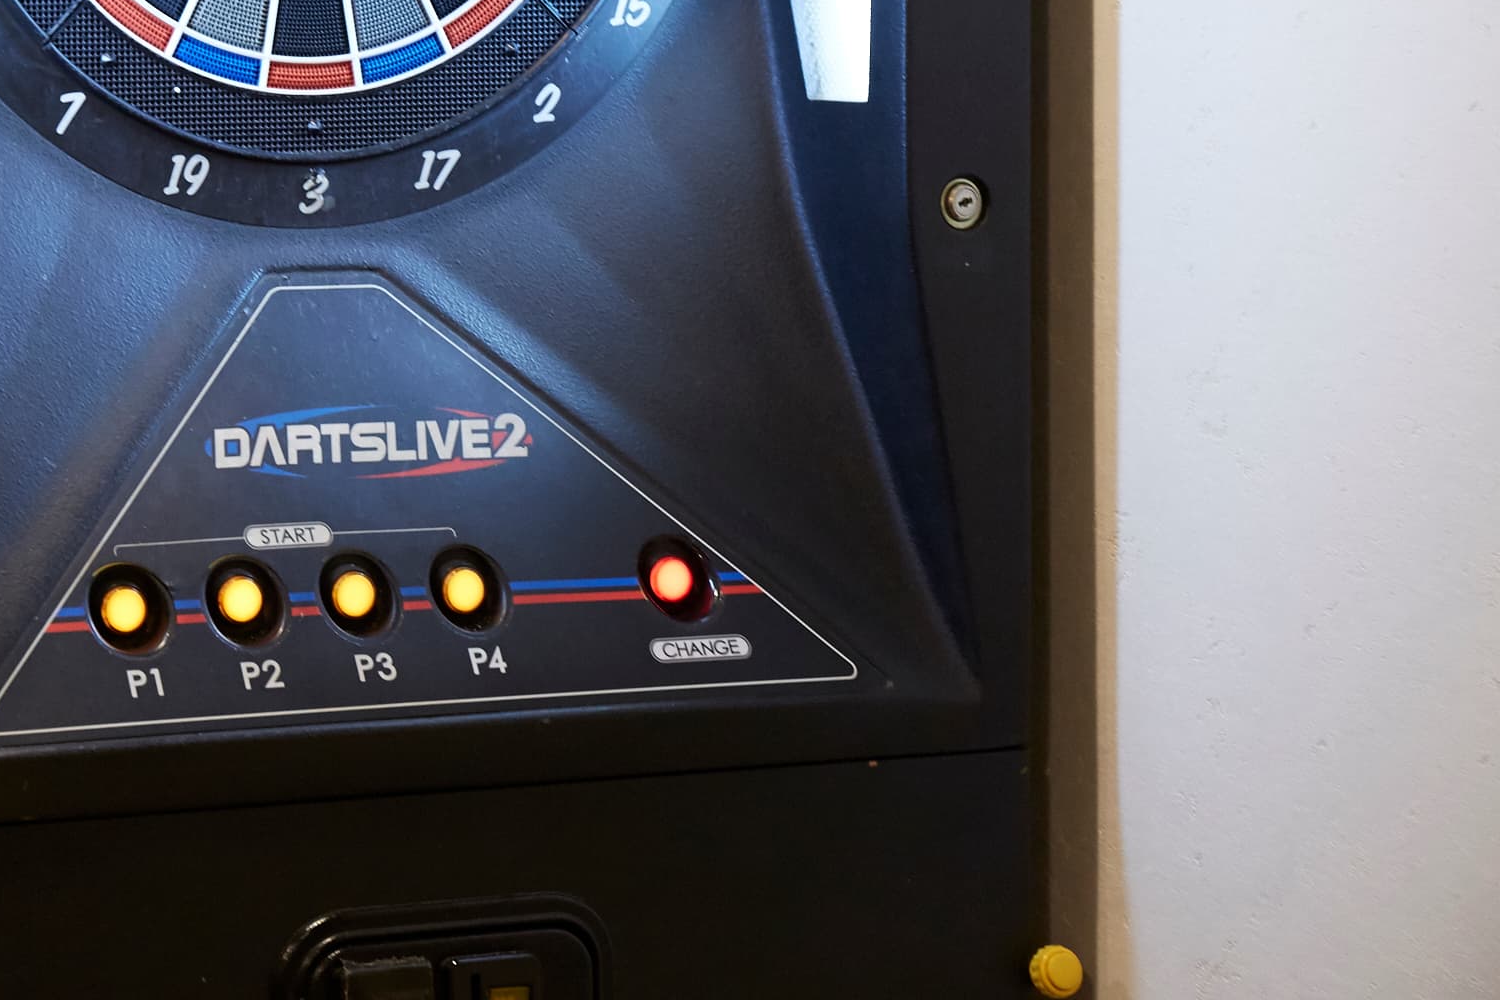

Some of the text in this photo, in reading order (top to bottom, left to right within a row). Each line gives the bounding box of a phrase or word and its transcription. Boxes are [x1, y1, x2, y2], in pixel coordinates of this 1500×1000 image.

[55, 91, 86, 135] 7
[533, 84, 561, 124] 2
[163, 154, 211, 196] 19
[414, 149, 461, 192] 17
[299, 173, 330, 215] 3
[260, 527, 316, 545] START
[662, 639, 741, 658] CHANGE
[126, 645, 508, 698] P1 P2 P3 P4
